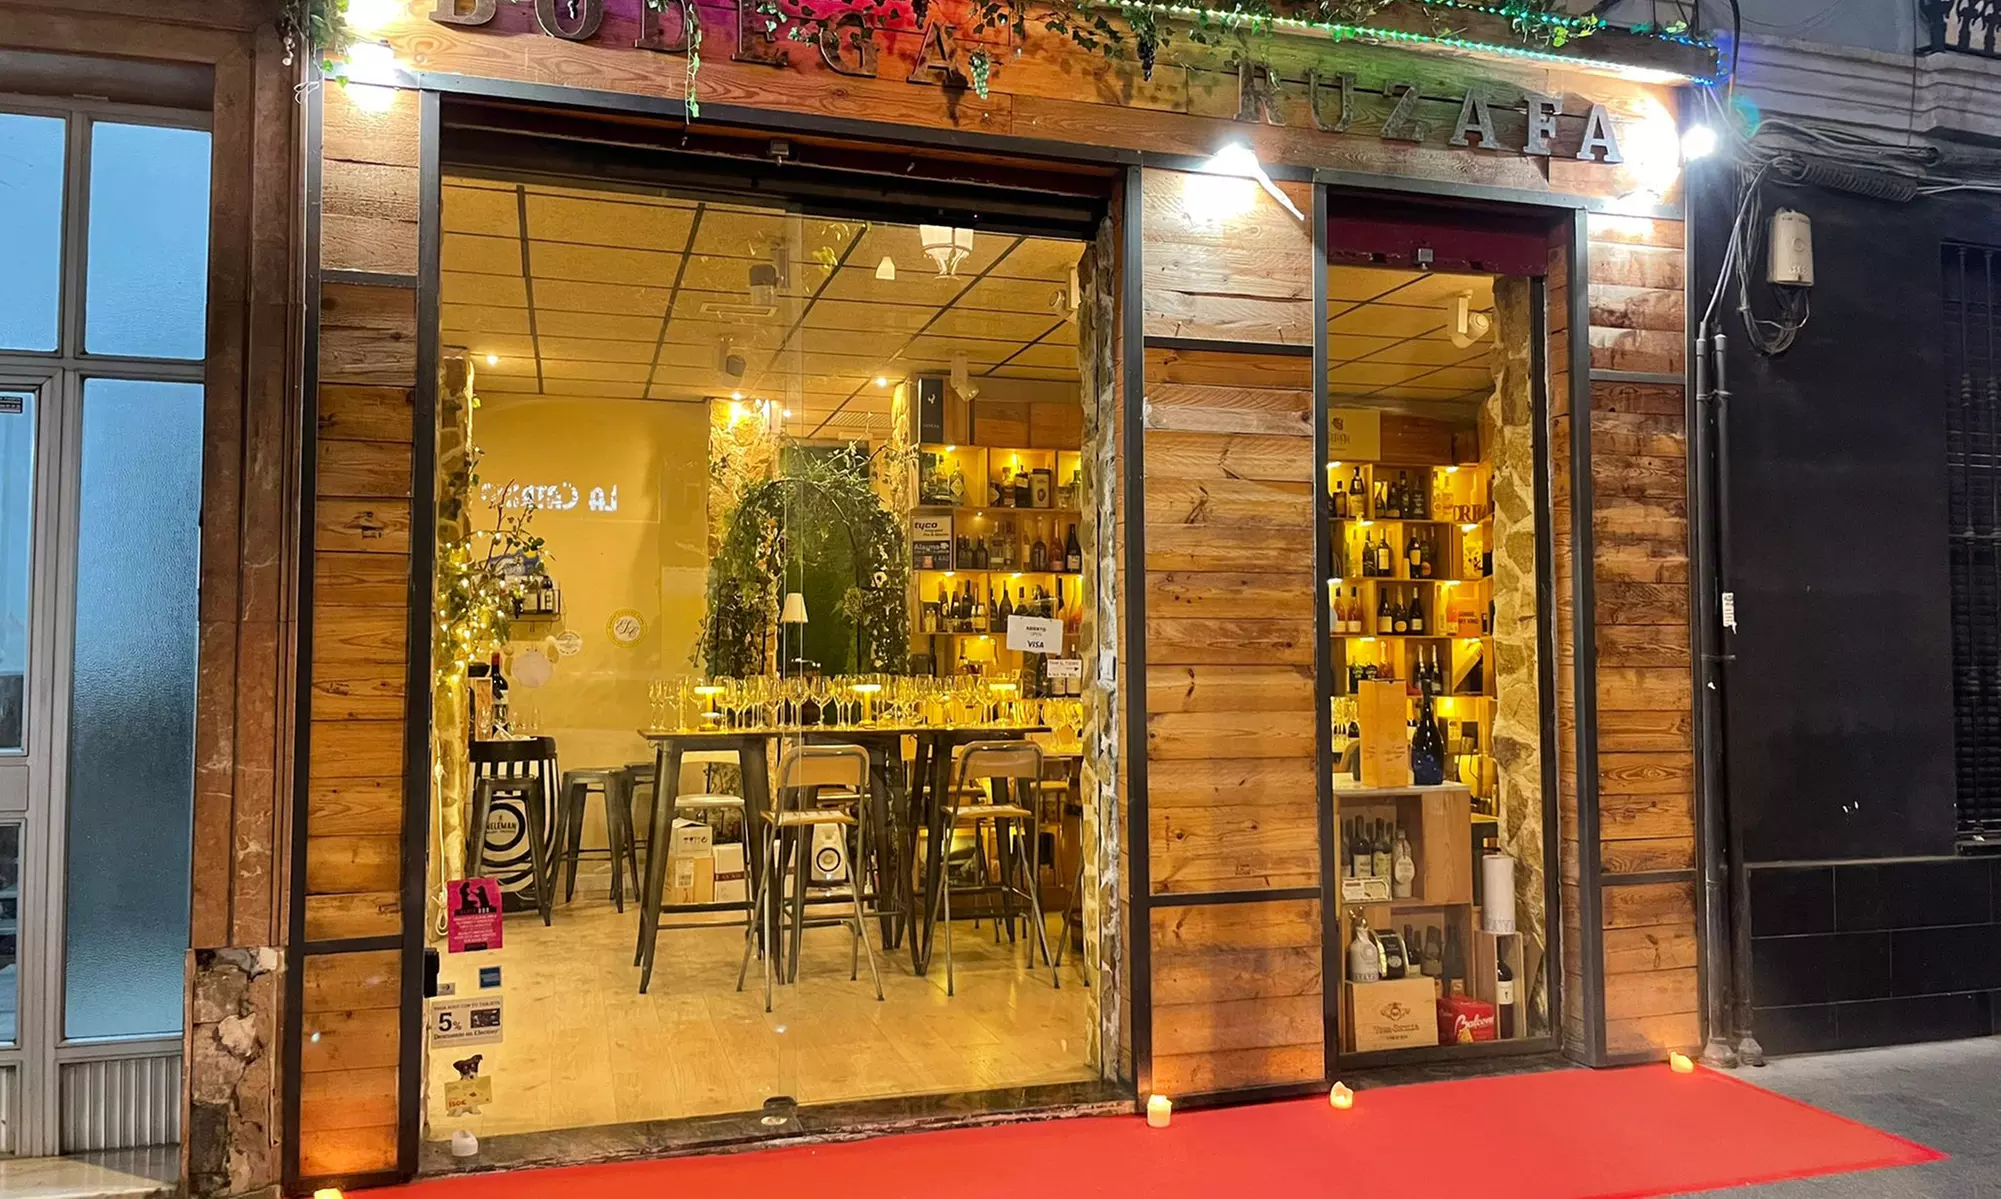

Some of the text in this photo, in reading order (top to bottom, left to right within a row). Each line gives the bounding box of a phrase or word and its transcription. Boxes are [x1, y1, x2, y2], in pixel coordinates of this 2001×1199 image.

[1223, 51, 1624, 164] RUZAFA
[914, 521, 938, 530] tyco
[1027, 640, 1044, 648] VISA
